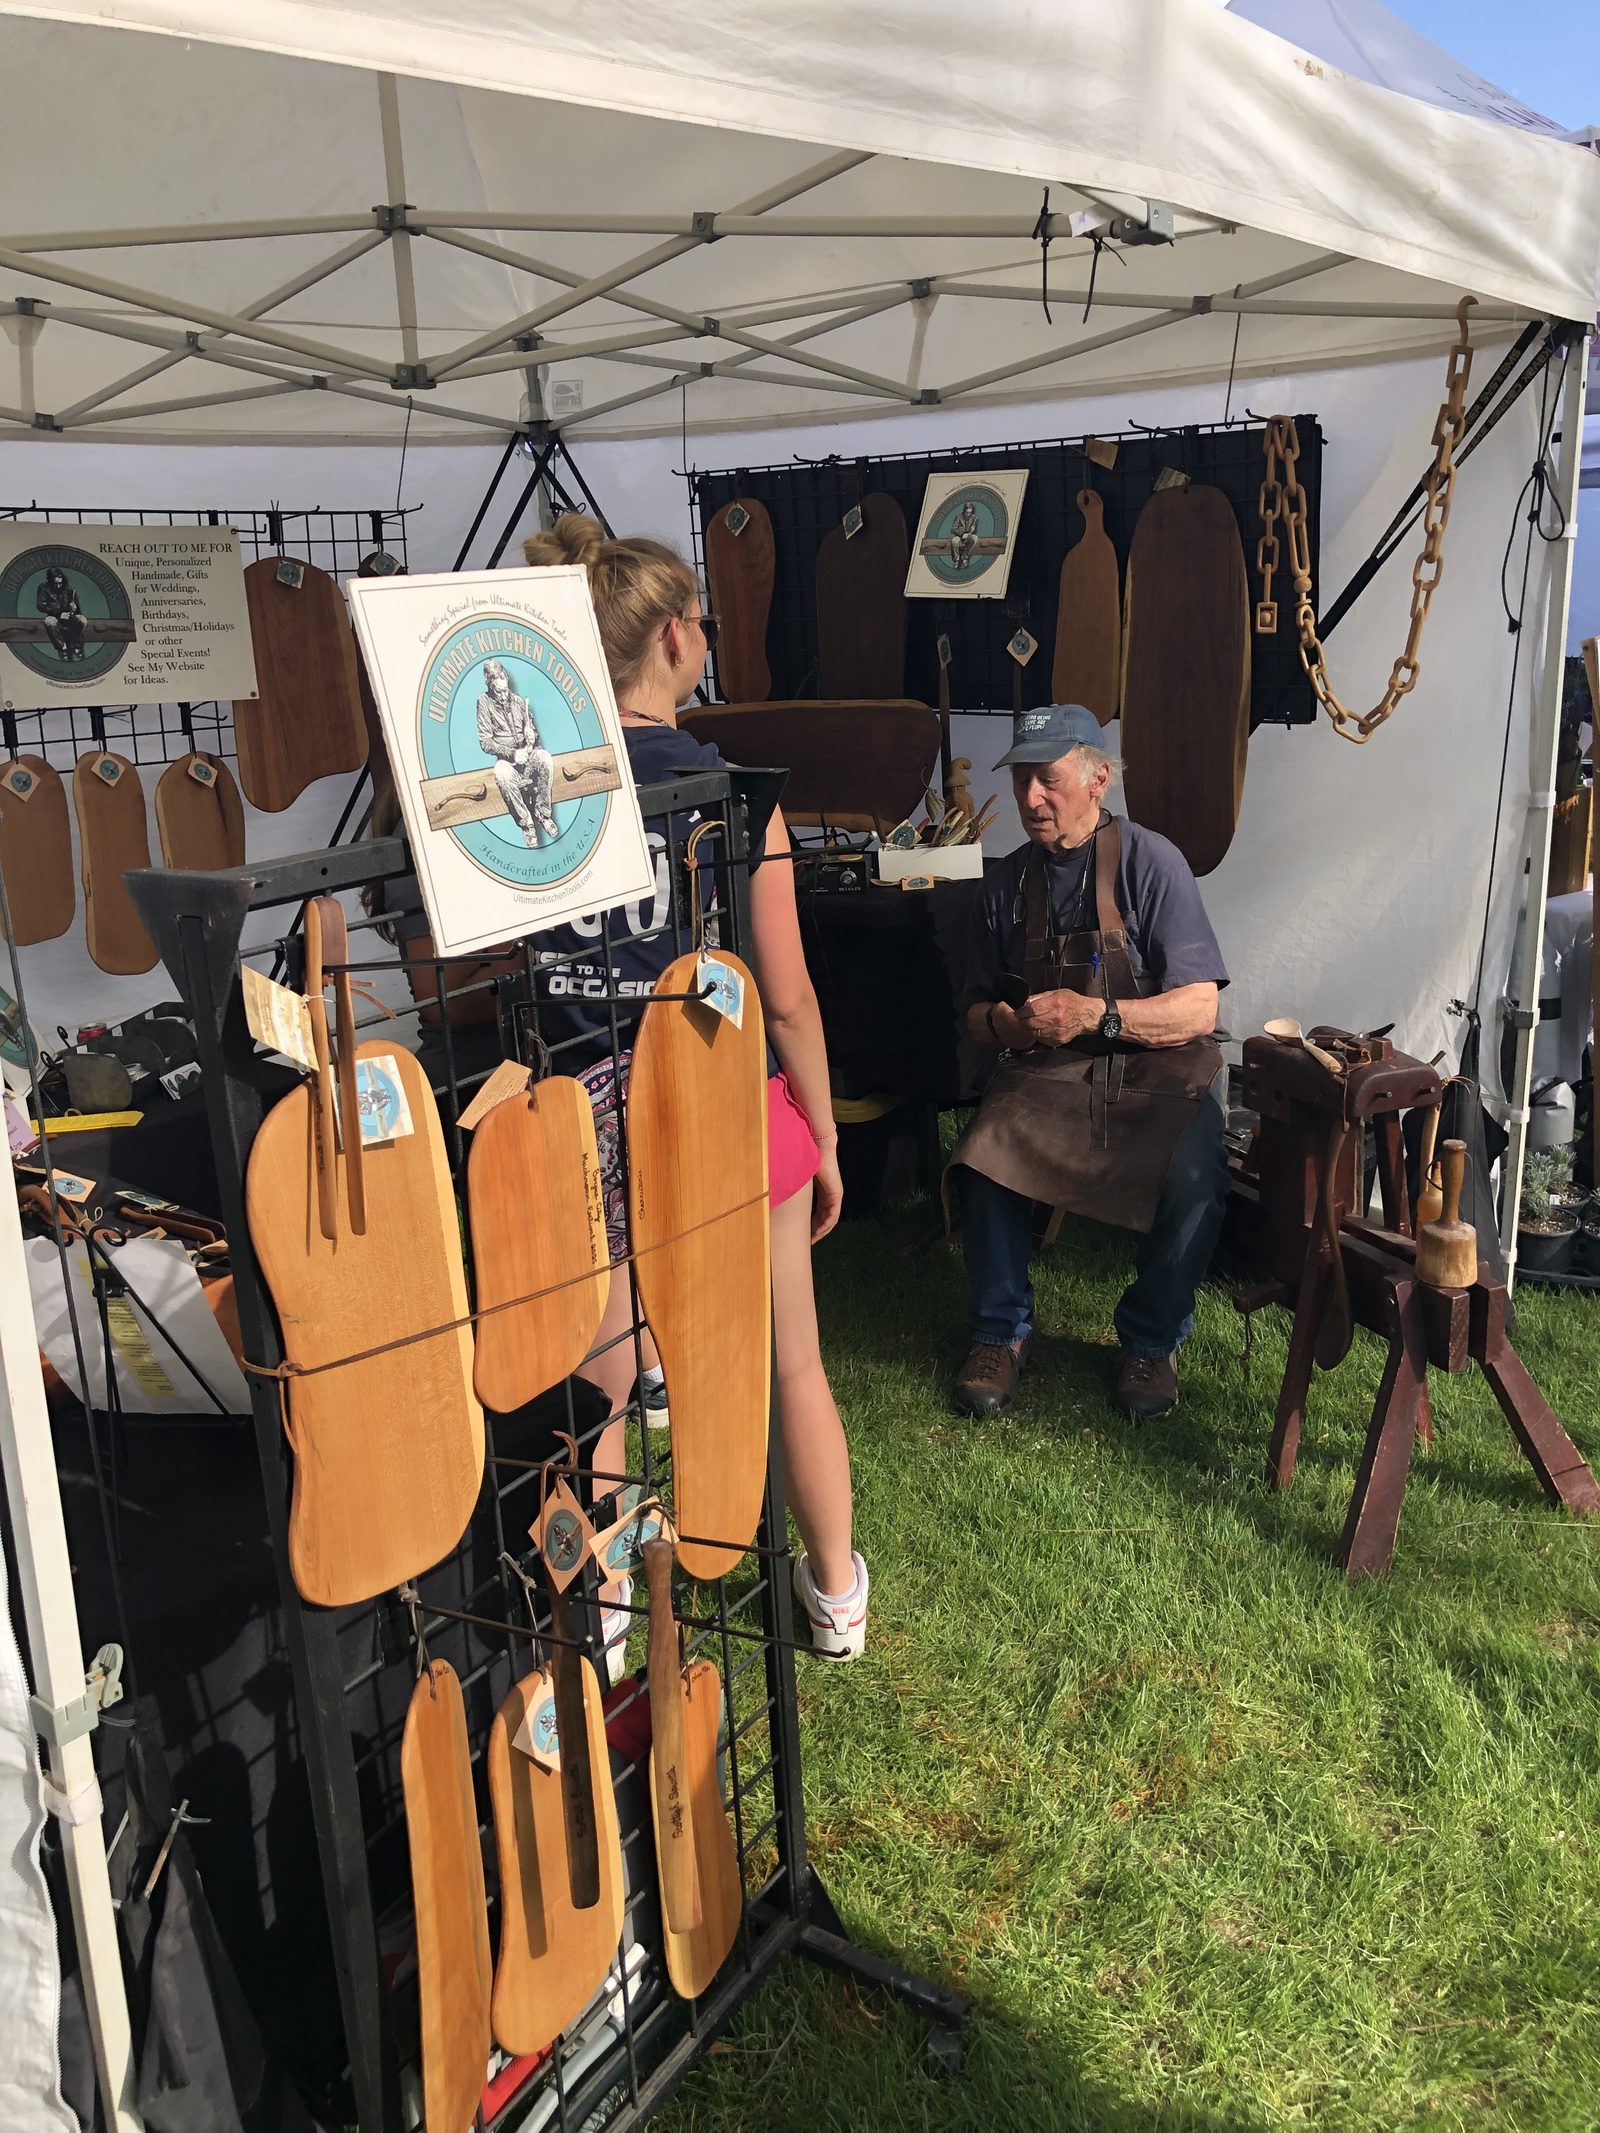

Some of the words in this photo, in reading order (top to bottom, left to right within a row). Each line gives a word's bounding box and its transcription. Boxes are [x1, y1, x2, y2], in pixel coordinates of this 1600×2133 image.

[99, 543, 140, 554] REACH
[143, 543, 169, 554] OUT
[171, 543, 188, 553] TO
[190, 543, 208, 553] ME
[209, 542, 233, 553] FOR
[115, 557, 154, 569] Unique,
[156, 556, 212, 567] Personalized
[131, 570, 185, 581] Handmade,
[186, 569, 209, 580] Gifts
[134, 584, 148, 594] for
[149, 583, 200, 594] Weddings,
[141, 596, 207, 607] Anniversaries,
[141, 610, 190, 620] Birthdays,
[418, 613, 451, 646] Something
[447, 597, 470, 618] Special
[471, 595, 489, 611] from
[490, 594, 522, 610] Ultimate
[523, 604, 550, 626] Kitchen
[551, 618, 568, 641] Tools
[142, 622, 236, 633] Christmas/Holidays
[144, 638, 155, 646] or
[158, 636, 183, 646] other
[140, 648, 175, 660] Special
[177, 648, 211, 658] Events!
[127, 663, 145, 673] See
[148, 662, 163, 673] My
[166, 661, 205, 671] Website
[123, 675, 138, 685] for
[140, 674, 169, 685] Ideas.
[428, 635, 479, 724] ULTIMATE
[474, 626, 545, 665] KITCHEN
[546, 651, 588, 715] TOOLS
[479, 844, 549, 880] Handcrafted
[551, 862, 561, 872] in
[562, 851, 577, 867] the
[513, 870, 594, 905] UltimateKitchenTools.com
[576, 964, 594, 976] TO
[548, 975, 657, 998] OCCASIO
[832, 1607, 850, 1615] NIKE
